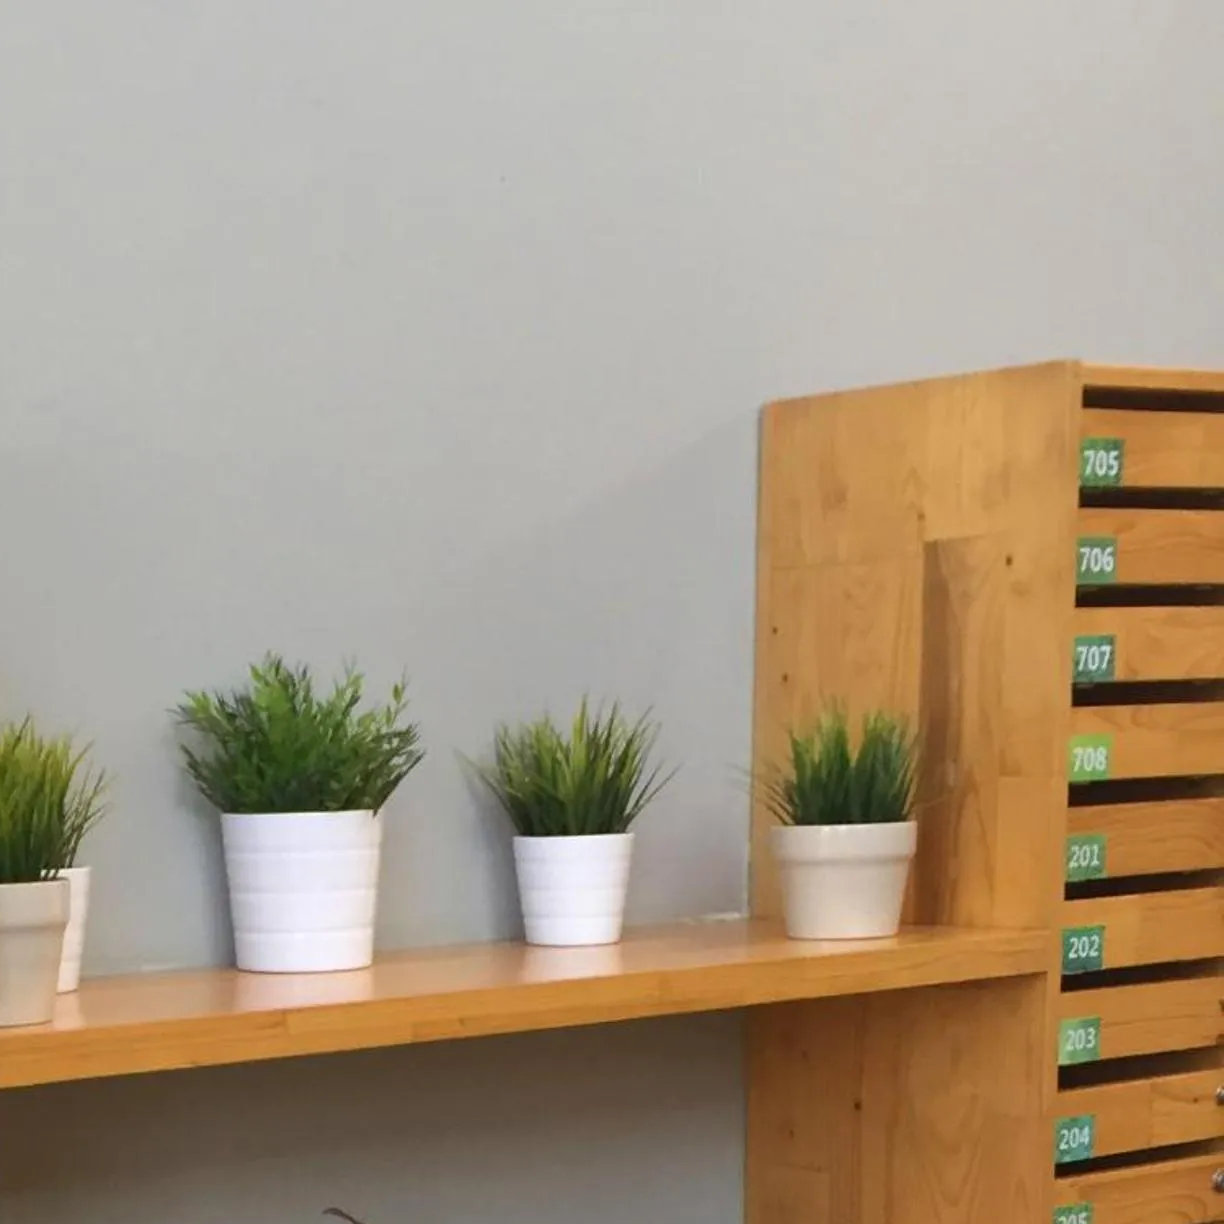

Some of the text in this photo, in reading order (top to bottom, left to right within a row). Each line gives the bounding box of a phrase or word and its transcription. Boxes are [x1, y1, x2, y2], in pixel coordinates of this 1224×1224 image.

[1084, 450, 1120, 477] 705
[1080, 547, 1115, 573] 706
[1077, 645, 1112, 672] 707
[1073, 746, 1107, 772] 708
[1069, 844, 1100, 868] 201
[1069, 935, 1100, 959] 202
[1065, 1029, 1096, 1052] 203
[1059, 1126, 1092, 1150] 204
